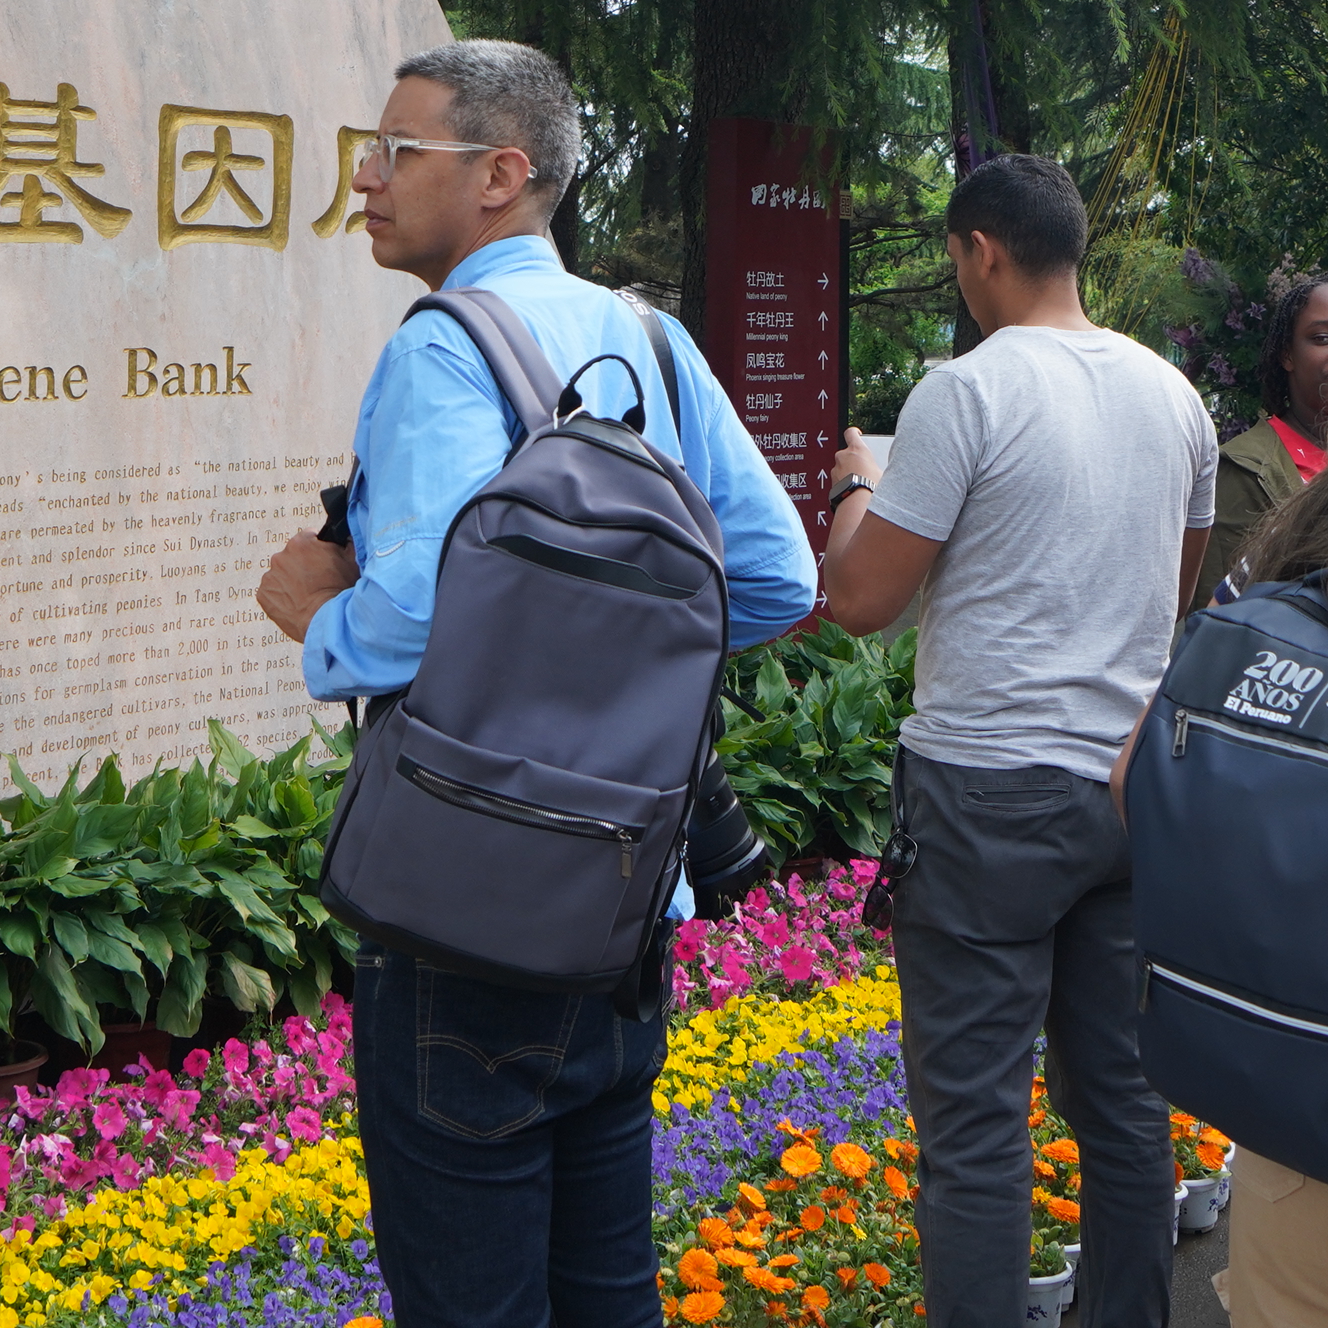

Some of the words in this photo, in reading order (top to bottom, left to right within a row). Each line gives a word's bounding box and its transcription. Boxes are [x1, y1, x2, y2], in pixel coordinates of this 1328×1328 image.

[746, 271, 785, 288] 牡丹故土
[746, 292, 760, 300] Native
[760, 292, 770, 300] land
[775, 293, 787, 301] peony
[746, 312, 794, 328] 千年牡丹王
[746, 333, 765, 341] Millennial
[766, 333, 779, 342] peony
[779, 333, 789, 342] king
[120, 344, 255, 401] Bank
[746, 352, 785, 369] 凤鸣宝花
[746, 373, 762, 381] Phoenix
[763, 373, 777, 382] singing
[793, 372, 805, 380] flower
[746, 393, 783, 409] 牡丹仙子
[746, 414, 759, 423] Peony
[760, 414, 769, 423] fairy
[51, 468, 86, 483] being
[94, 463, 161, 480] considered
[168, 465, 181, 475] as
[228, 456, 277, 471] national
[284, 455, 320, 469] beauty
[326, 453, 344, 466] and
[775, 453, 794, 461] collection
[118, 492, 131, 506] by
[139, 490, 159, 503] the
[167, 485, 218, 501] national
[273, 483, 287, 493] we
[293, 478, 321, 493] enjoy
[0, 529, 21, 541] are
[31, 520, 94, 539] permeated
[102, 518, 115, 532] by
[124, 517, 143, 530] the
[151, 512, 203, 528] heavenly
[210, 508, 267, 523] fragrance
[273, 506, 287, 518] at
[292, 503, 322, 517] night
[31, 549, 52, 565] and
[61, 544, 116, 564] splendor
[123, 542, 156, 558] since
[163, 538, 182, 552] Sui
[190, 533, 240, 550] Dynasty.
[247, 531, 258, 545] In
[264, 529, 289, 545] Tang
[51, 574, 72, 589] and
[81, 568, 153, 589] prosperity.
[160, 563, 207, 579] Luoyang
[214, 561, 226, 572] as
[234, 557, 252, 571] the
[10, 607, 24, 623] of
[33, 600, 108, 621] cultivating
[116, 594, 162, 613] peonies
[175, 591, 187, 605] In
[195, 589, 220, 603] Tang
[228, 586, 258, 600] Dynas
[27, 633, 56, 649] were
[64, 628, 92, 644] many
[102, 623, 155, 640] precious
[162, 617, 181, 632] and
[189, 615, 215, 628] rare
[222, 609, 270, 626] cultiva
[0, 664, 21, 678] has
[29, 660, 58, 675] once
[66, 652, 100, 669] toped
[107, 650, 136, 665] more
[144, 646, 170, 660] than
[178, 639, 209, 657] 2,000
[217, 637, 229, 652] in
[237, 635, 254, 649] its
[261, 632, 292, 647] golde
[34, 686, 55, 702] for
[63, 678, 127, 699] germplasm
[134, 666, 213, 688] conservation
[221, 662, 232, 676] in
[241, 659, 259, 673] the
[266, 654, 295, 670] past,
[1244, 651, 1323, 693] 200
[14, 716, 35, 731] the
[43, 703, 113, 726] endangered
[121, 696, 186, 715] cultivars,
[193, 691, 213, 705] the
[219, 682, 270, 701] National
[277, 678, 306, 693] Peony
[1224, 695, 1238, 711] El
[1240, 702, 1292, 724] Peruano
[1229, 678, 1305, 712] AÑOS
[11, 741, 33, 757] and
[41, 729, 118, 754] development
[125, 724, 139, 741] of
[148, 720, 181, 739] peony
[256, 708, 276, 720] was
[282, 700, 330, 718] approved
[132, 751, 152, 765] has
[161, 742, 211, 761] collecte
[257, 729, 302, 747] species,
